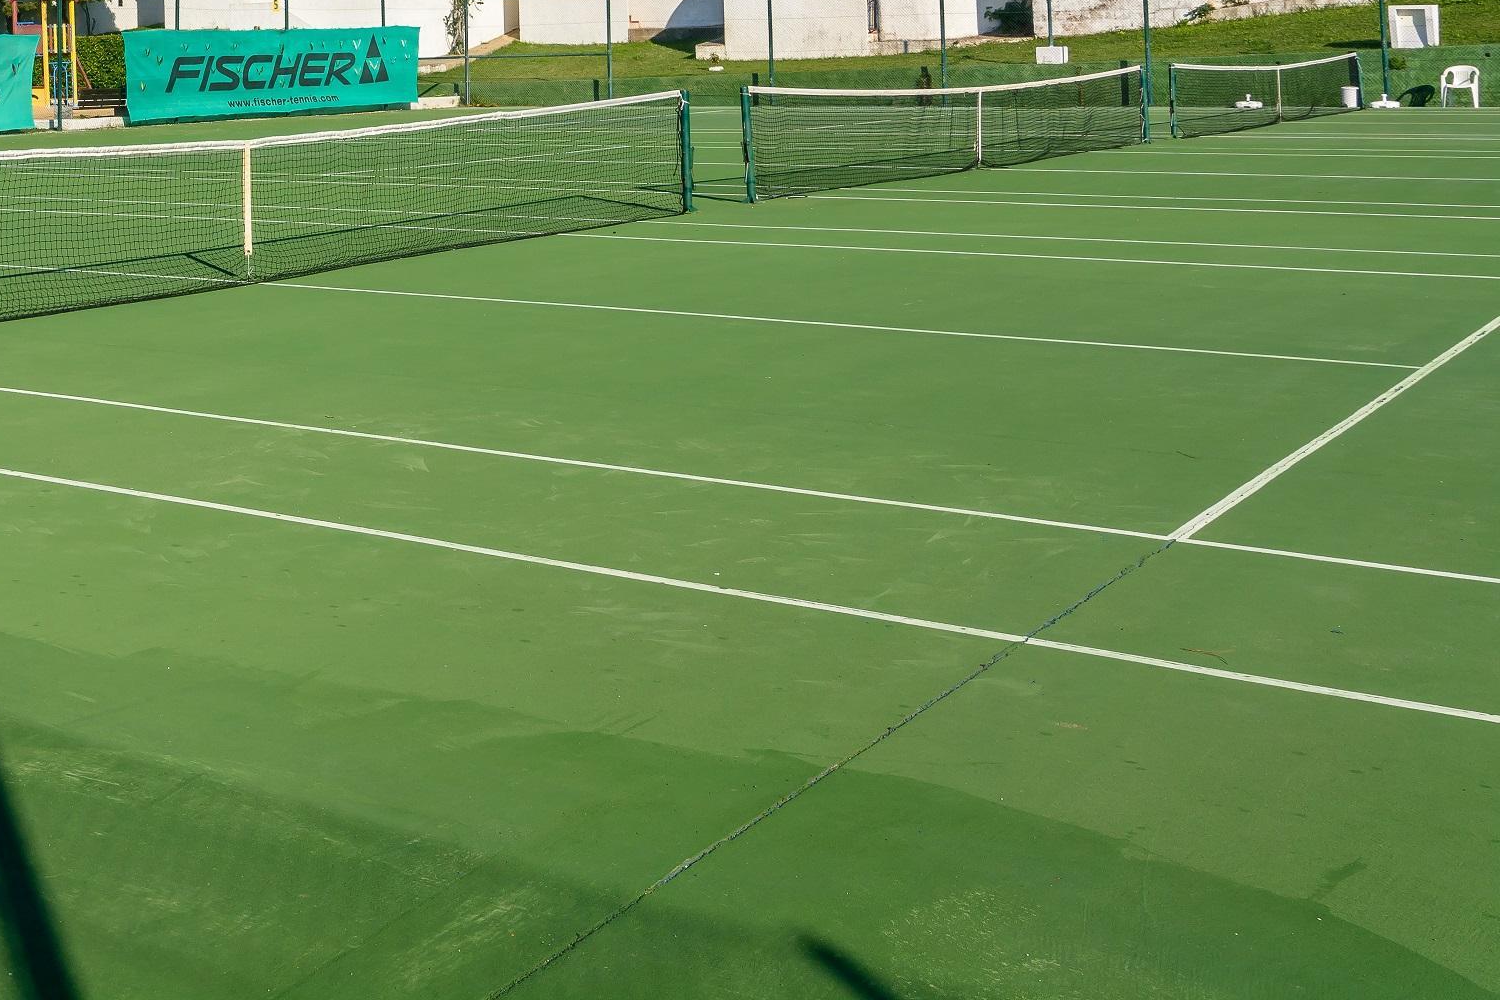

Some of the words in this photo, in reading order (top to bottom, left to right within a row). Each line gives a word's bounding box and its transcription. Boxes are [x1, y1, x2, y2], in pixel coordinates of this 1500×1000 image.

[273, 0, 279, 10] 5
[165, 53, 356, 93] FISCHER
[227, 94, 340, 108] www.fischer-tennis.com
